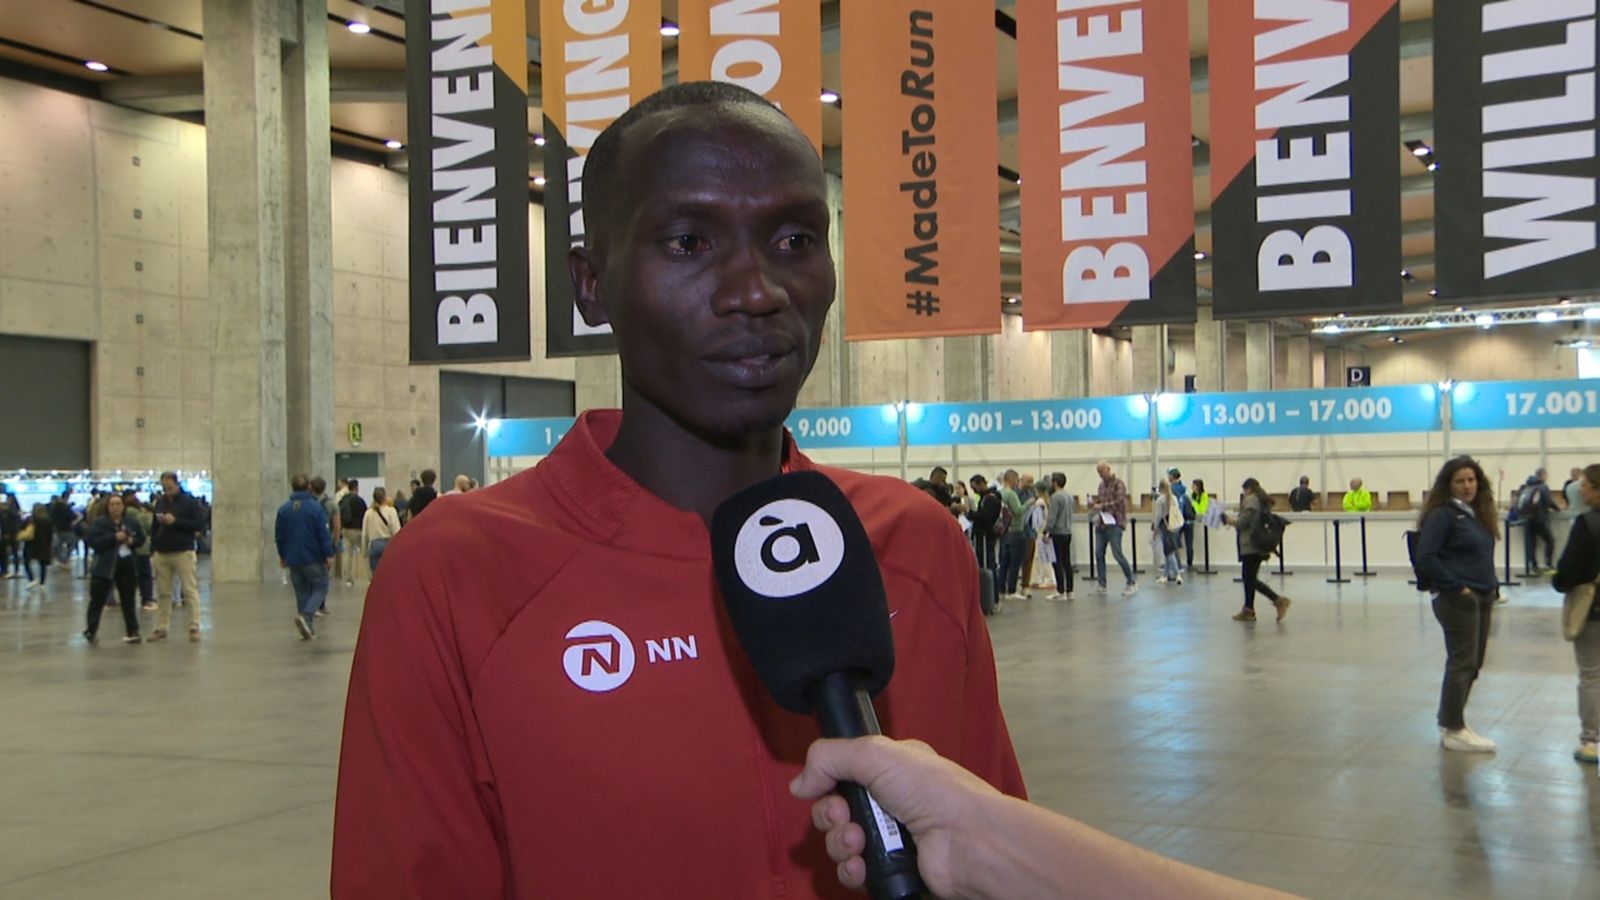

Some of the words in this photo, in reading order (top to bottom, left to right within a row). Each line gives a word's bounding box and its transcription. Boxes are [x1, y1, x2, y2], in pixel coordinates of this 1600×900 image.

[900, 10, 941, 317] #MadeToRun
[1056, 0, 1151, 304] BENVE
[1351, 368, 1364, 382] D
[1201, 402, 1277, 425] 13.001
[1309, 397, 1393, 423] 17.000
[1505, 391, 1597, 415] 17.001
[799, 416, 851, 437] 9.000
[948, 412, 1003, 432] 9.001
[1030, 408, 1102, 431] 13.000
[758, 515, 821, 573] à
[645, 634, 698, 664] NN
